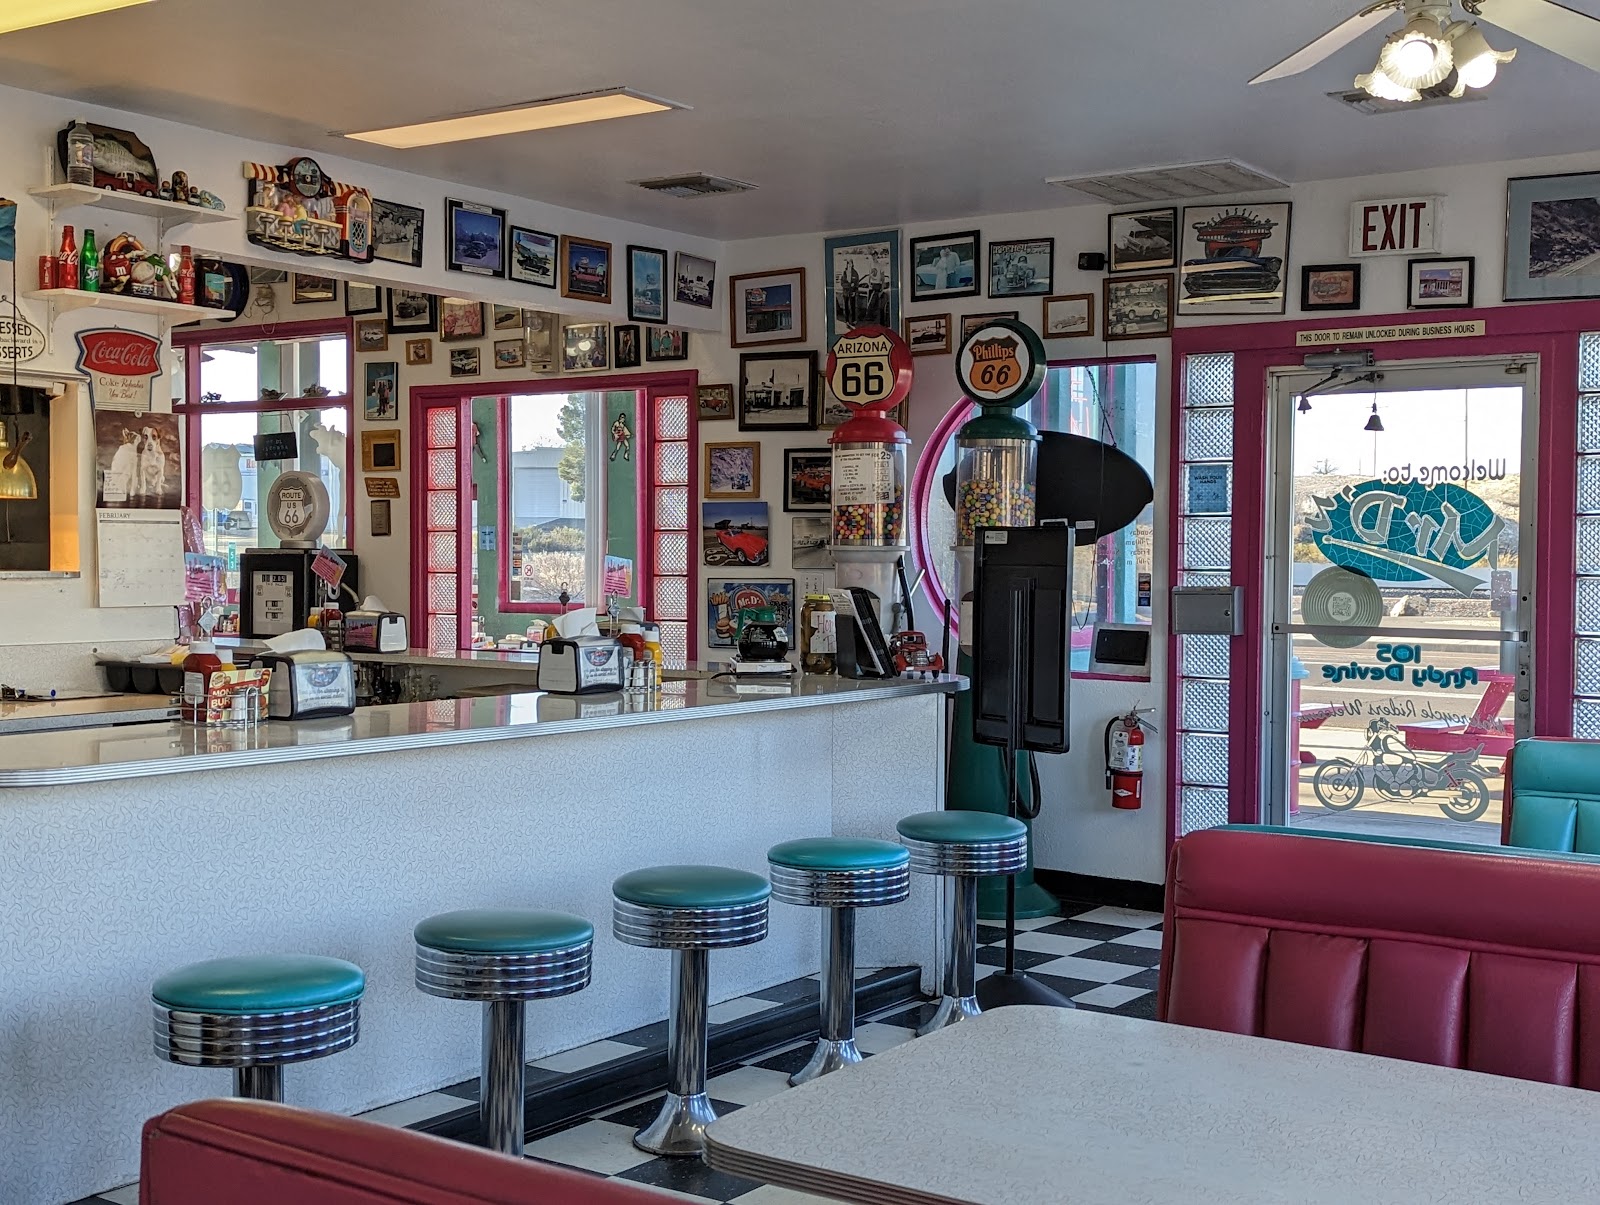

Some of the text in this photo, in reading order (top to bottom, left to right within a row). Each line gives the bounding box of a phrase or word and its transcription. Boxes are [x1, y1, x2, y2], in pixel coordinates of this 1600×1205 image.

[1362, 202, 1426, 251] EXIT
[1300, 324, 1475, 343] THIS DOOR TO REMAIN UNLOCKED DURING BUSINESS HOURS
[0, 346, 33, 359] SERTS
[837, 341, 888, 354] ARIZONA
[973, 343, 1014, 361] Phillips
[99, 377, 119, 387] Coke
[842, 361, 884, 396] 66
[981, 364, 1011, 385] 66
[284, 509, 299, 524] 66
